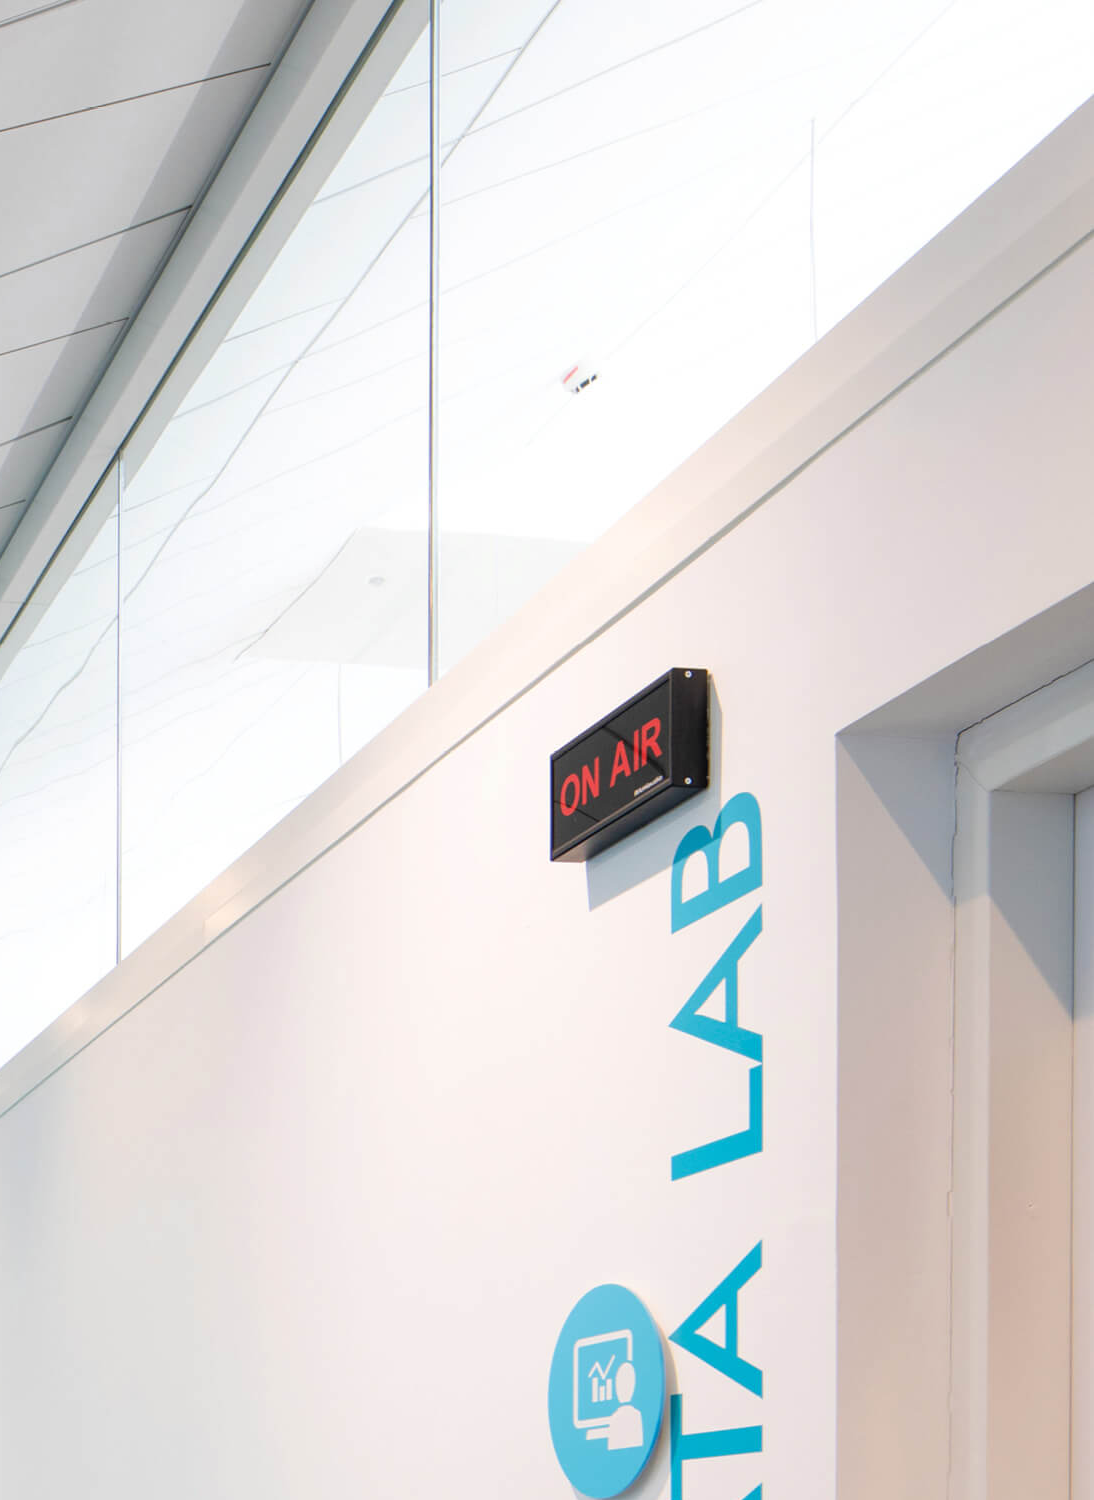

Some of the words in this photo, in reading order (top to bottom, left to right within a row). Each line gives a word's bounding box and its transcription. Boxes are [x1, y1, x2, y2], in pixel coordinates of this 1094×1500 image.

[560, 756, 600, 817] ON
[609, 717, 663, 788] AIR
[668, 791, 763, 1182] LAB
